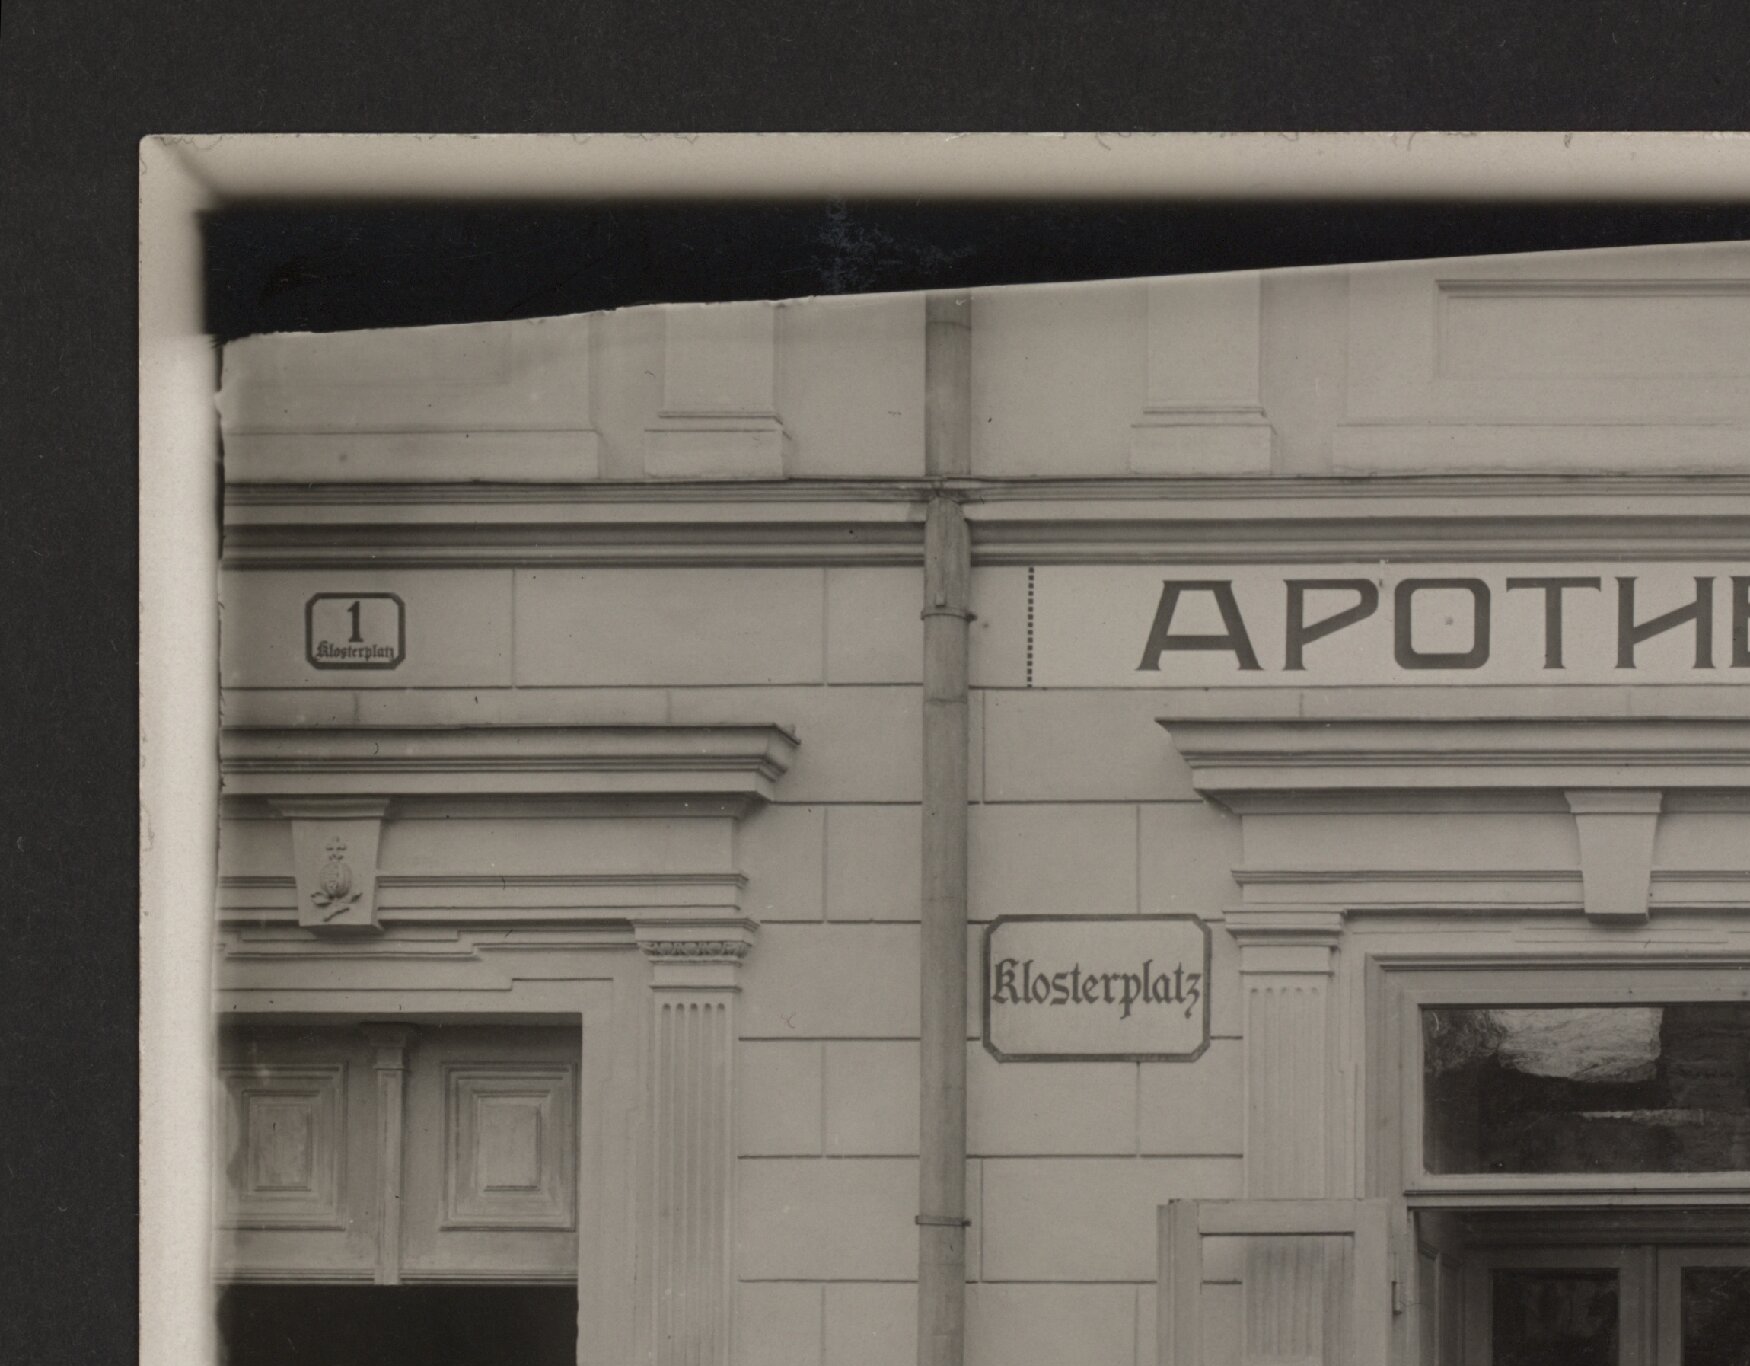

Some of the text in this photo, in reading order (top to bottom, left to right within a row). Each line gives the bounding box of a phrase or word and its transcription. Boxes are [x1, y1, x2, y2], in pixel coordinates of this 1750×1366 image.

[346, 600, 365, 643] 1
[315, 639, 396, 662] Klosterplatz
[991, 957, 1202, 1020] Klosterplatz
